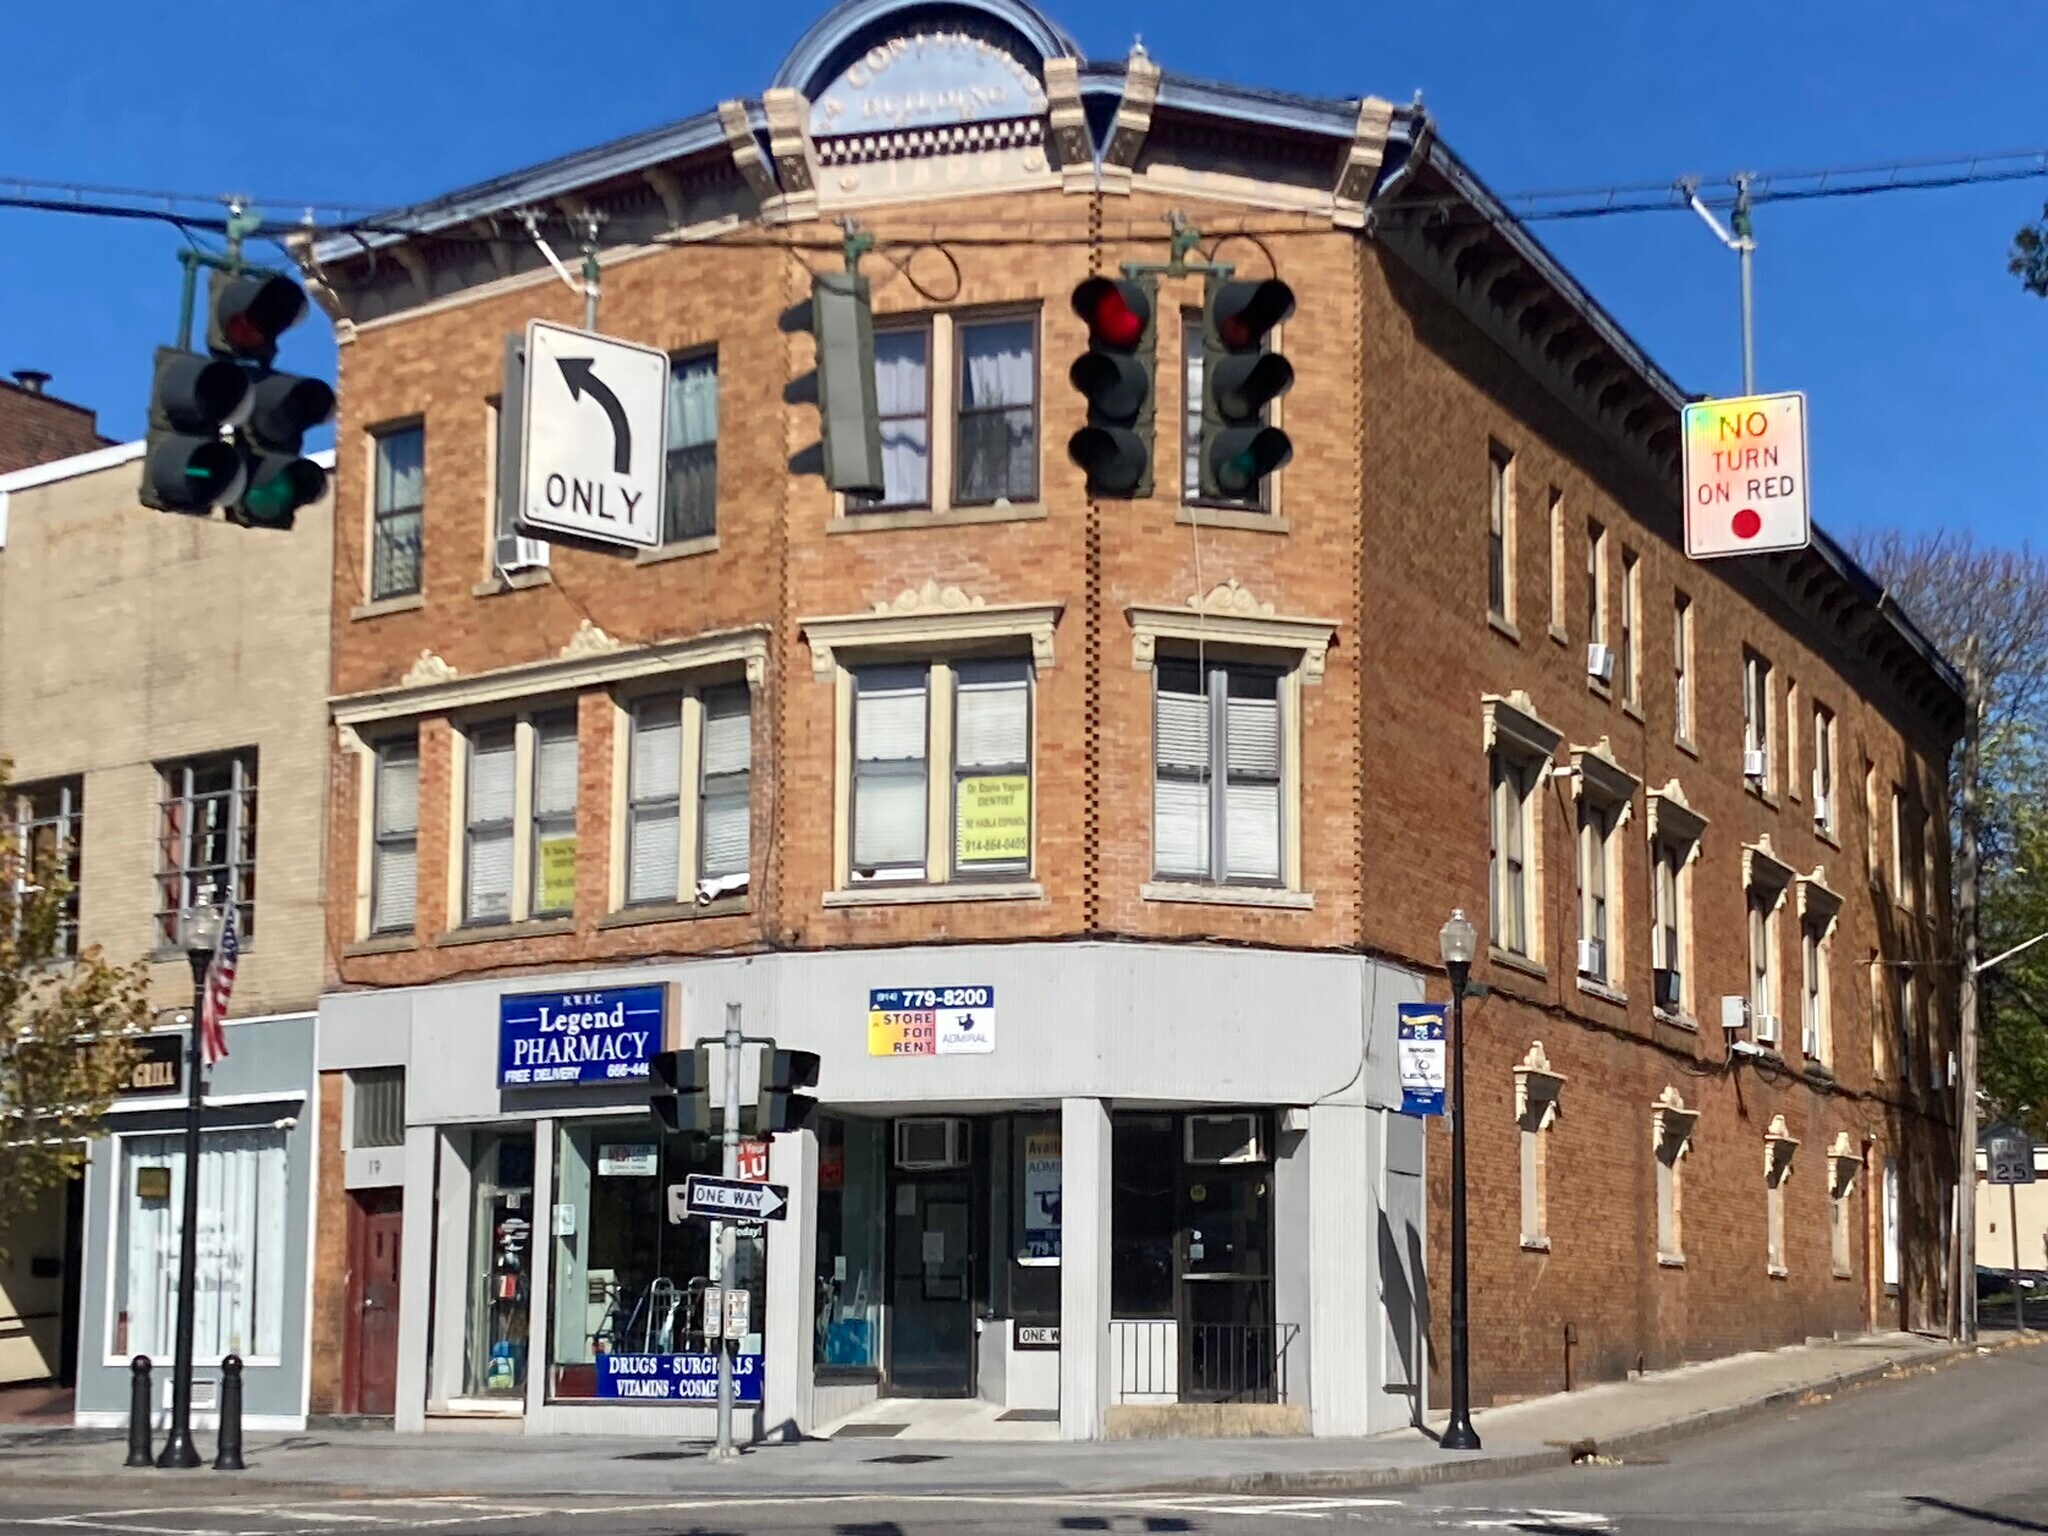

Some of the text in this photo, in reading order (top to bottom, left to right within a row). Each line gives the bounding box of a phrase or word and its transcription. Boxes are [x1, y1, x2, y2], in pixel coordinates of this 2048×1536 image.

[1720, 412, 1768, 441] NO
[1712, 446, 1778, 473] TURN
[1698, 475, 1794, 505] ON RED
[546, 474, 642, 524] ONLY
[902, 989, 987, 1007] 779-8200
[538, 1002, 625, 1035] Legend
[883, 1013, 932, 1025] STORE
[903, 1027, 932, 1038] FOR
[942, 1033, 988, 1044] ADMIRAL
[513, 1031, 650, 1066] PHARMACY
[893, 1042, 932, 1053] RENT
[504, 1069, 531, 1083] FREE
[533, 1066, 582, 1082] DELIVERY
[1028, 1140, 1061, 1155] Avail
[1027, 1161, 1061, 1174] ADMI
[1995, 1163, 2026, 1180] 25
[696, 1187, 764, 1207] ONE WAY
[735, 1224, 762, 1239] oday!
[1022, 1329, 1046, 1341] ONE
[609, 1356, 753, 1374] DRUGS SURGILS
[617, 1379, 741, 1397] VITAMINS COSMES
